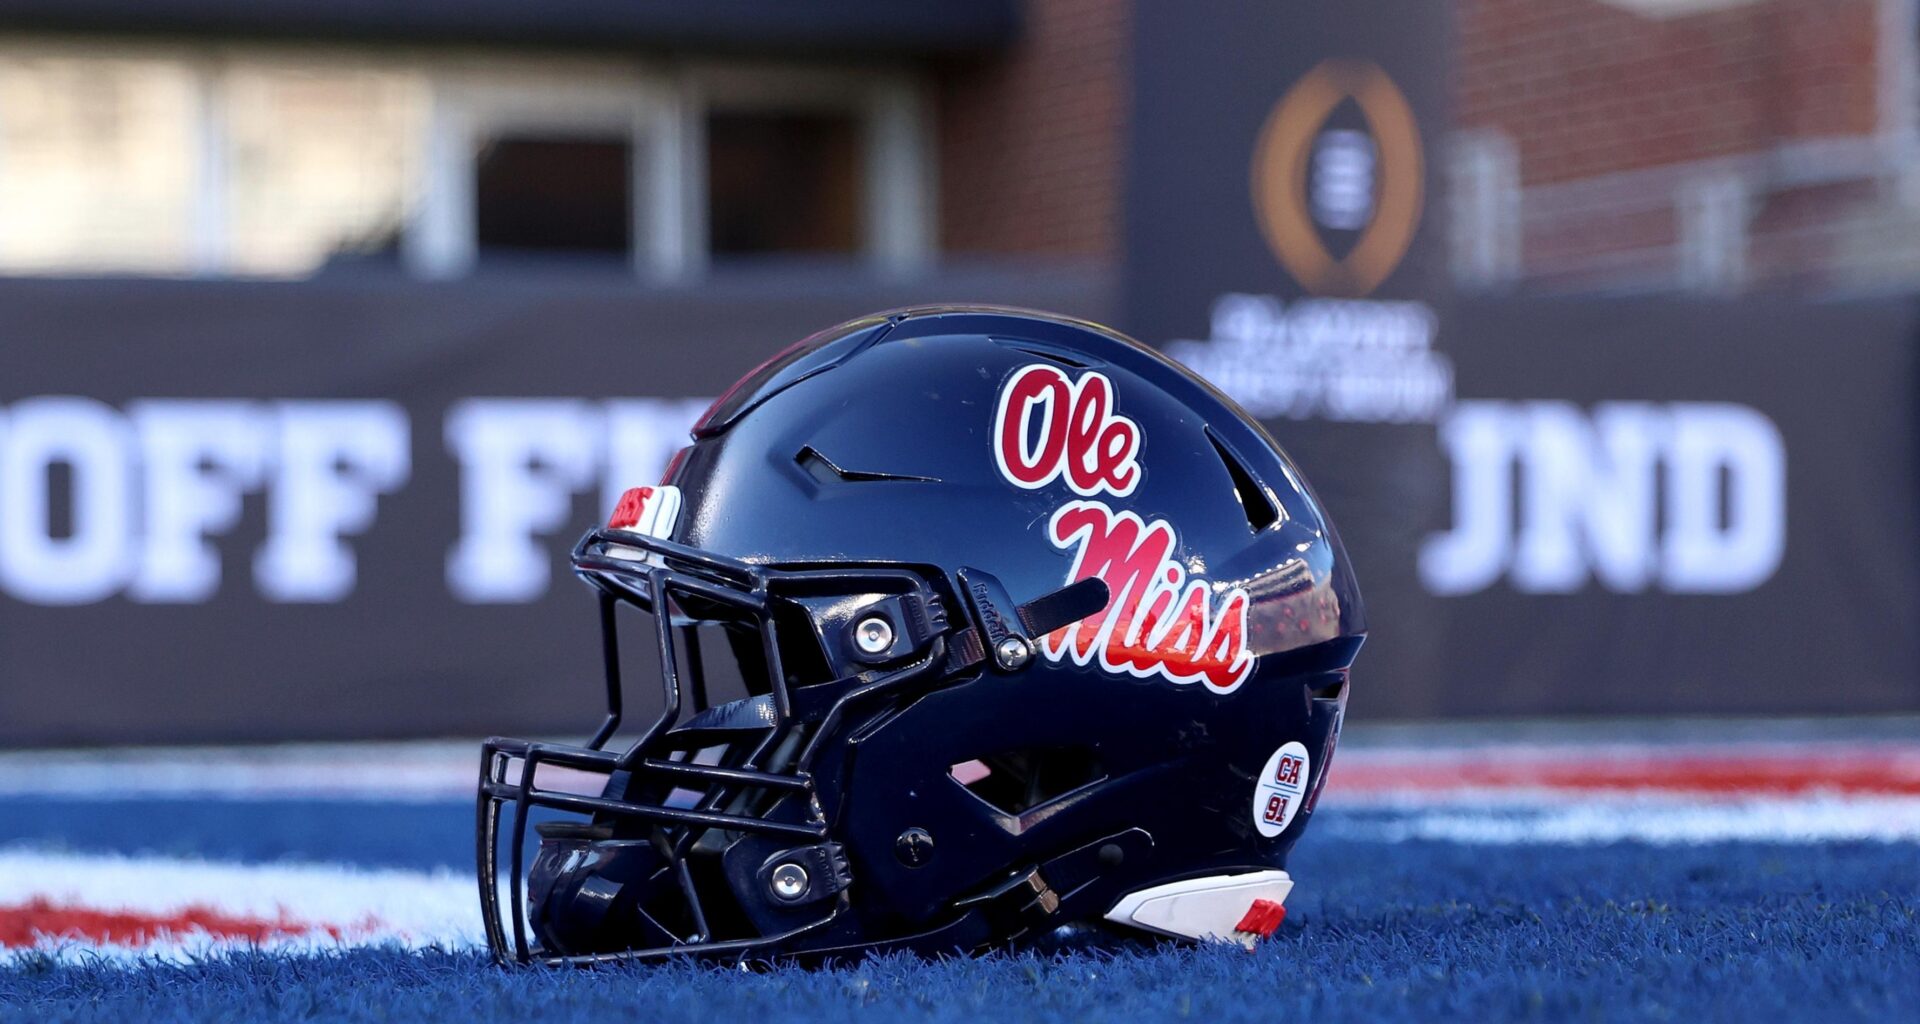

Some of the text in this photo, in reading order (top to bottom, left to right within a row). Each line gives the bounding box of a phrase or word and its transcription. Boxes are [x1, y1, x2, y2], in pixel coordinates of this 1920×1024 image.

[994, 364, 1141, 497] Ole
[1041, 500, 1255, 695] Miss
[1263, 793, 1290, 826] 91
[1275, 753, 1304, 786] CA
